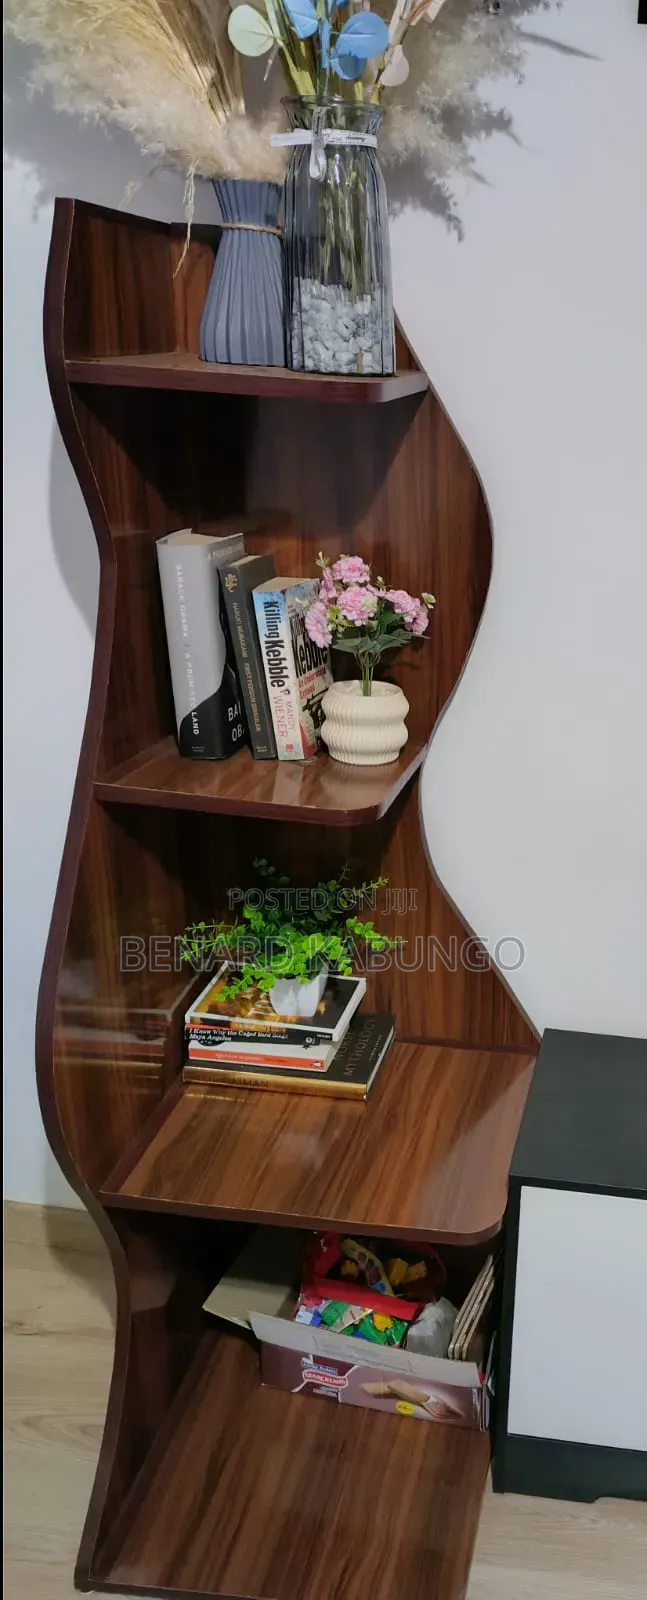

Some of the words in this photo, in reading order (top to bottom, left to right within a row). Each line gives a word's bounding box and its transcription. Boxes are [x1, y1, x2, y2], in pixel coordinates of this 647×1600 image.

[263, 600, 281, 638] Killing
[180, 604, 189, 637] OBAMA
[191, 711, 200, 735] LAND
[264, 639, 289, 688] Kebble
[228, 702, 242, 722] BA
[273, 695, 289, 738] WIENER
[286, 700, 295, 731] MANDY
[231, 723, 245, 742] OB
[188, 1033, 206, 1041] Maya
